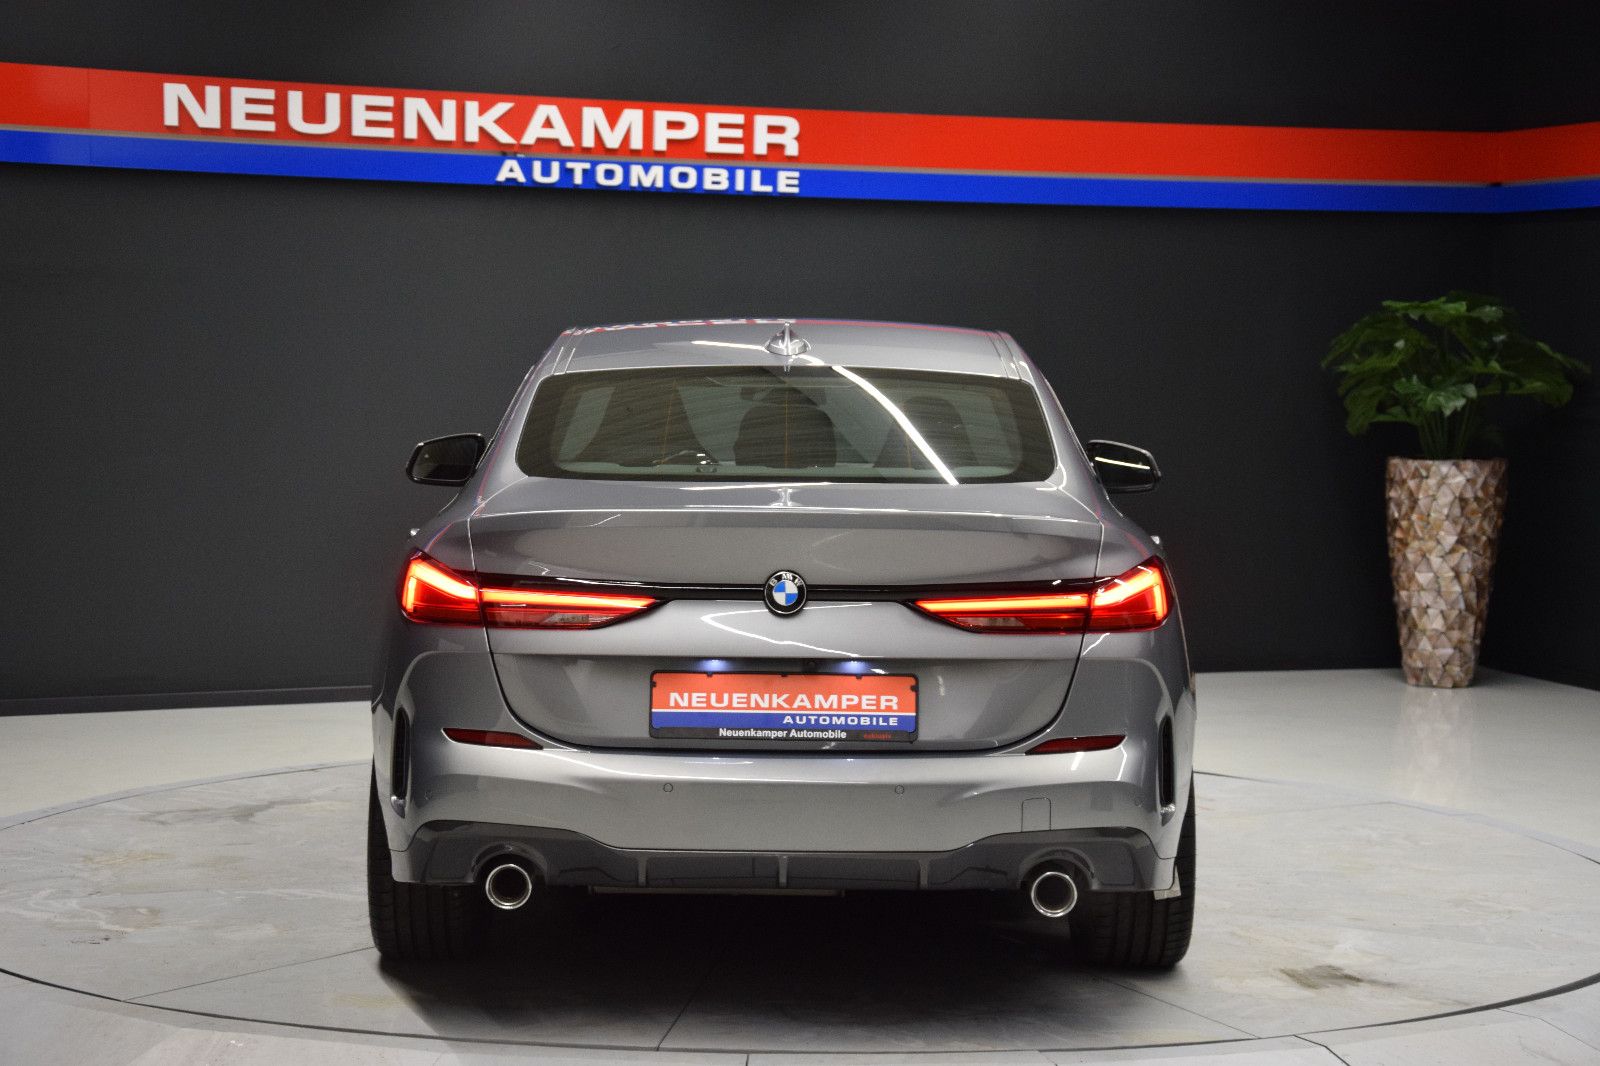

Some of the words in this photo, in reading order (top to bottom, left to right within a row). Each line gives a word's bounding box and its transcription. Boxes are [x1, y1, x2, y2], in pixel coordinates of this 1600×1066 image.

[163, 82, 800, 157] NEUENKAMPER
[496, 159, 800, 193] AUTOMOBILE
[770, 573, 803, 586] BMW
[669, 692, 898, 710] NEUENKAMPER
[783, 715, 898, 726] AUTOMOBILE
[719, 728, 787, 739] Neuenkamper
[789, 729, 847, 738] Automobile
